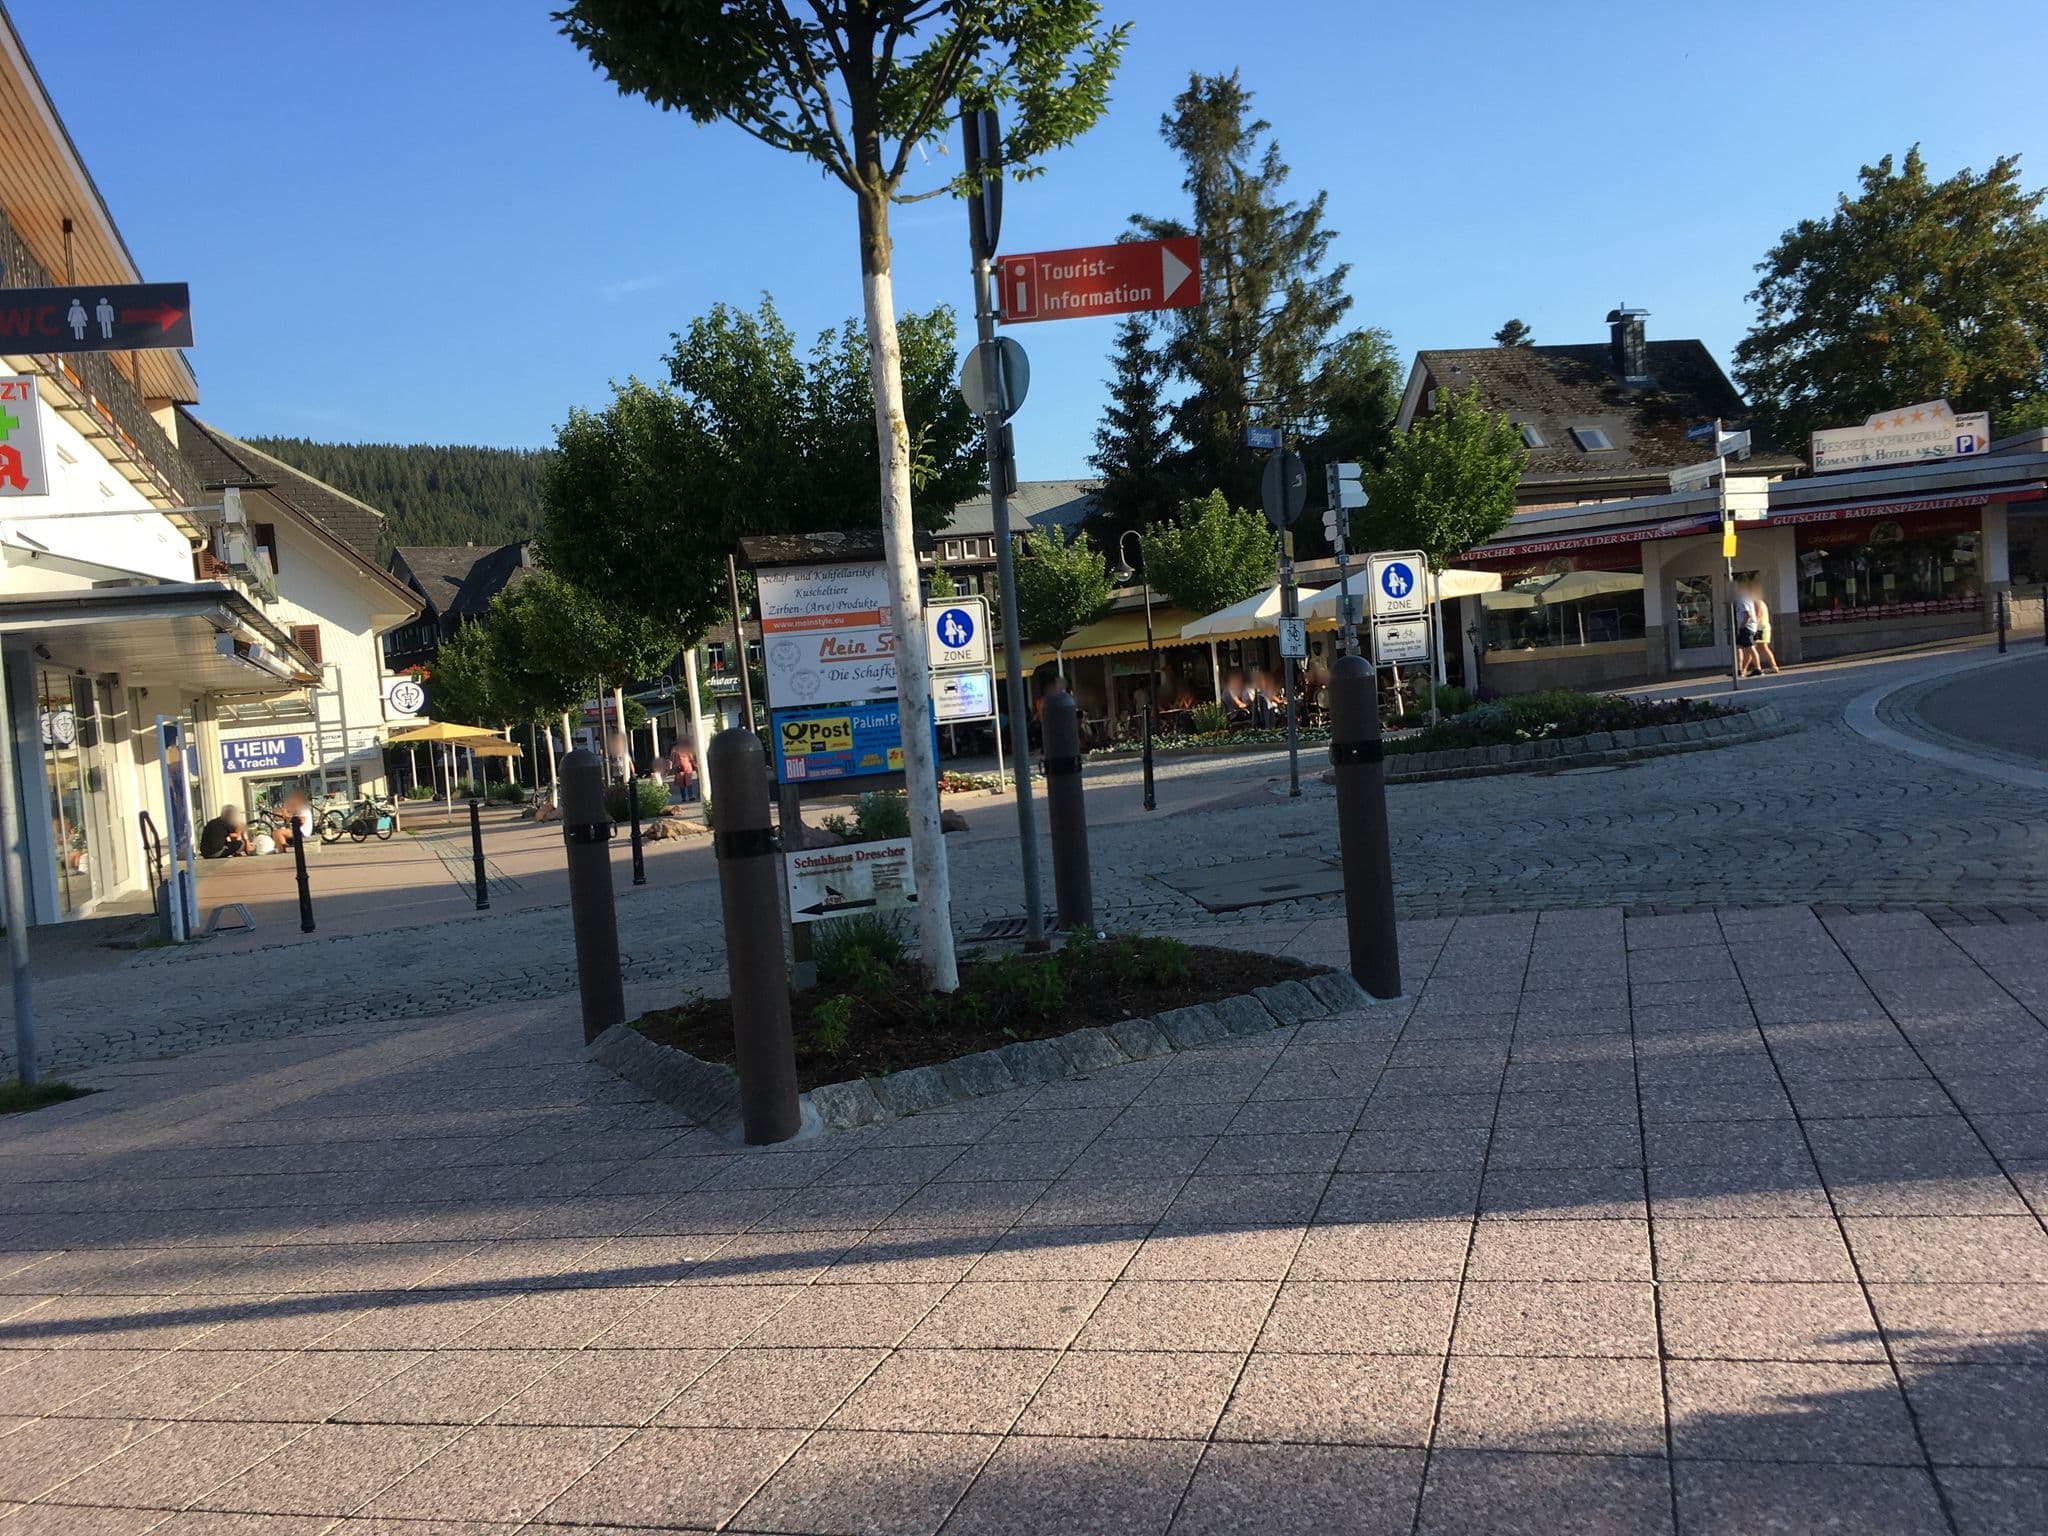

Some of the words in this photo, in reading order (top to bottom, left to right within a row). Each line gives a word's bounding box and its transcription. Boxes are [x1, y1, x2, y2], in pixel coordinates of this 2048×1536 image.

[1042, 258, 1115, 280] Tourist-
[1044, 284, 1151, 310] Information
[0, 306, 60, 337] WC
[1773, 510, 1838, 526] GUTSCHER
[1461, 547, 1516, 561] GUTSCHER
[794, 570, 811, 582] und
[814, 567, 876, 582] Kuhfellartikel
[794, 586, 849, 599] Kuscheltiere
[768, 603, 802, 616] Zirben-
[805, 600, 835, 614] (Arve)
[838, 597, 879, 610] Produkte
[1387, 600, 1412, 610] ZONE
[773, 616, 845, 630] www.meinstyle.eu
[819, 636, 867, 657] Mein
[876, 633, 897, 653] St
[943, 650, 973, 661] ZONE
[828, 667, 849, 682] Die
[810, 721, 850, 739] Post
[234, 740, 286, 759] HEIM
[227, 760, 236, 770] &
[239, 757, 279, 769] Tracht
[785, 757, 806, 779] Bild
[855, 846, 906, 861] Drescher
